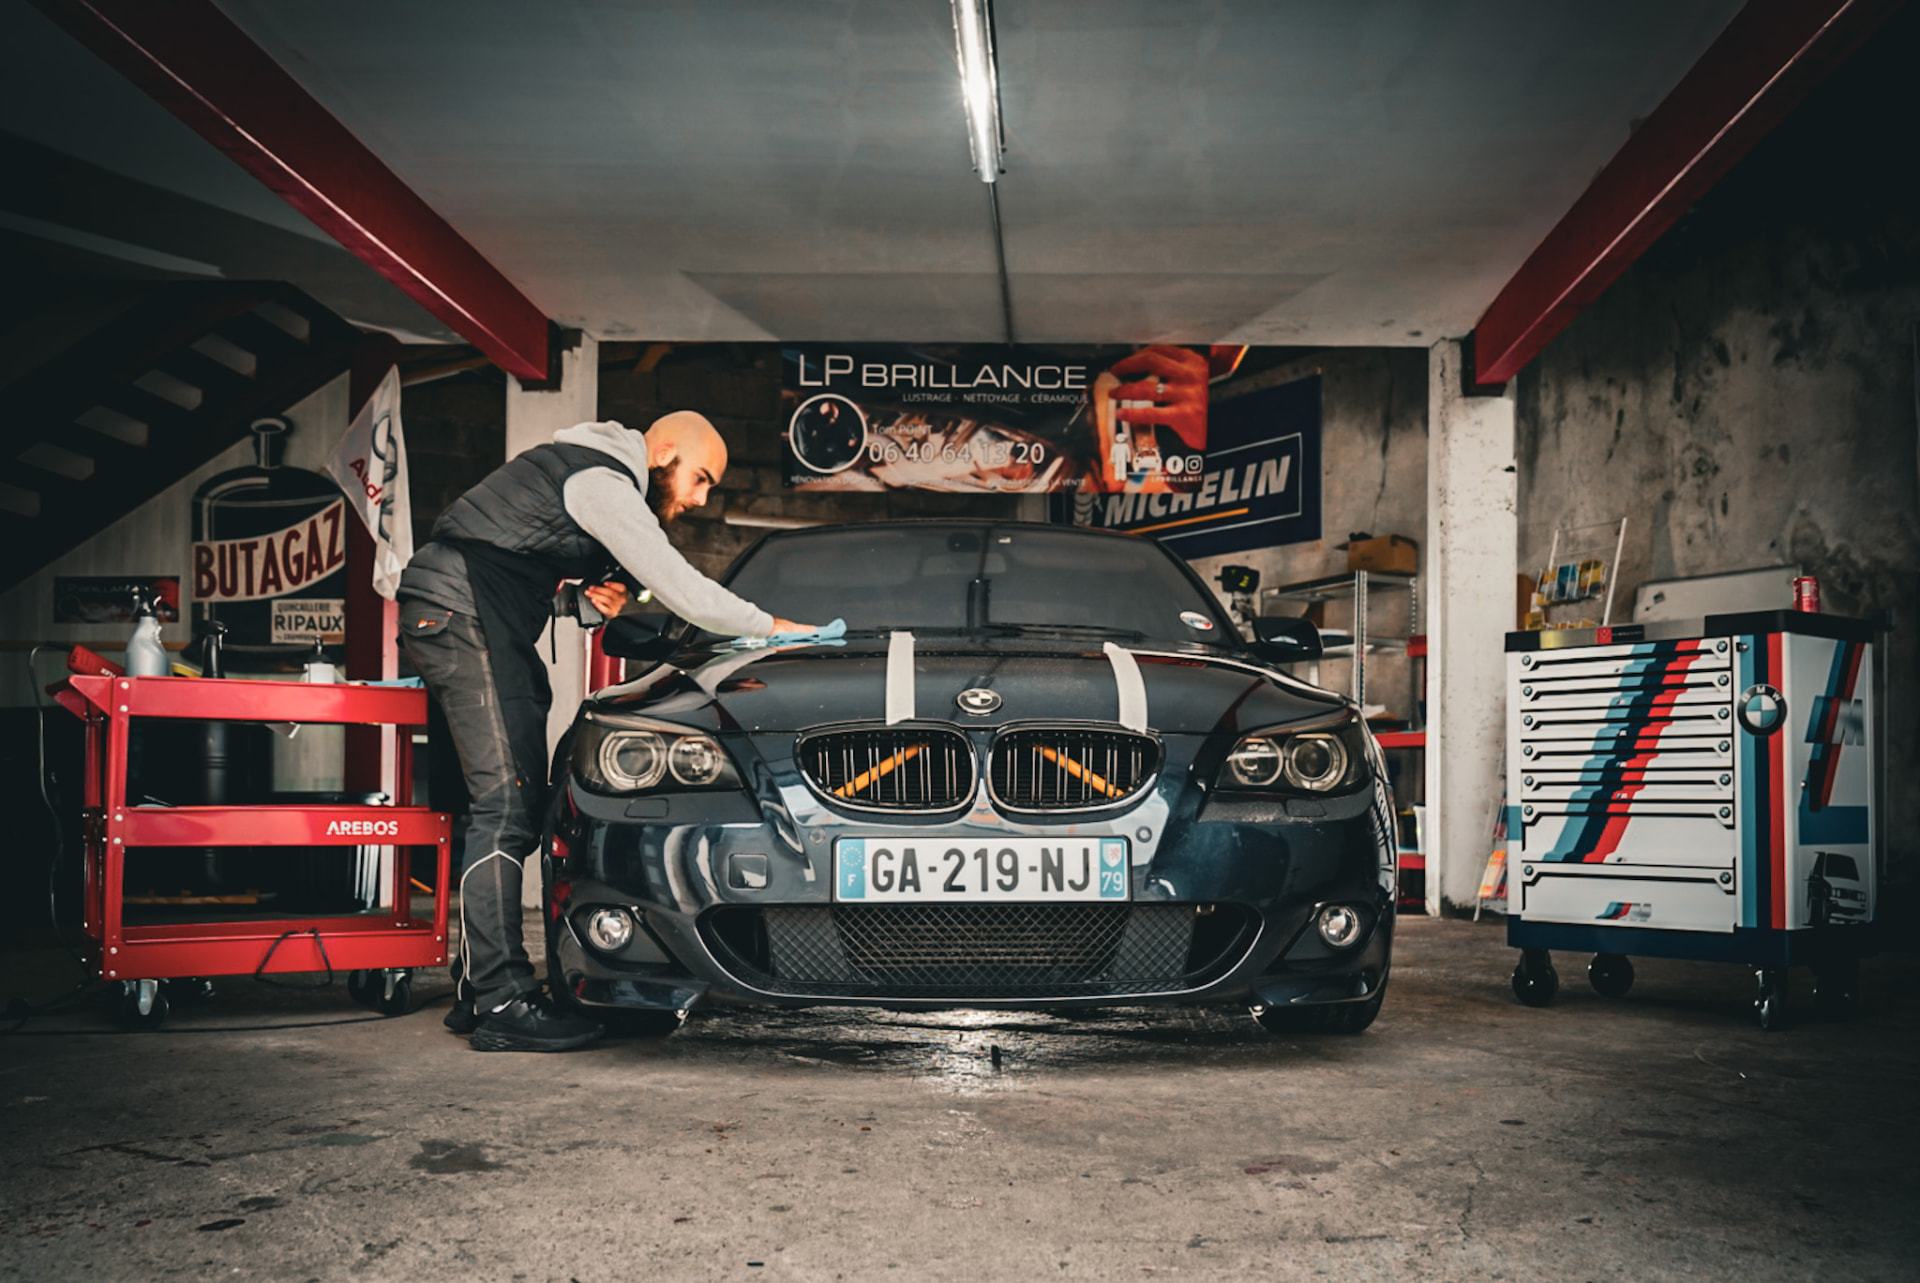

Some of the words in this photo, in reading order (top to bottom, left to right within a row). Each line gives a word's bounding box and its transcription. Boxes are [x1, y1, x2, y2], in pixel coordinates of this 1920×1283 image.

[799, 354, 854, 387] LP
[861, 363, 1087, 389] BRILLANCE
[902, 392, 952, 403] LUSTRAGE
[963, 393, 1020, 404] NETTOYAGE
[868, 441, 898, 463] 06
[905, 442, 934, 464] 40
[941, 442, 972, 464] 64
[981, 442, 1008, 465] 13
[1015, 442, 1045, 465] 20
[350, 457, 383, 506] Audi
[1103, 455, 1291, 527] MICHELIN
[194, 502, 345, 598] BUTAGAZ
[274, 614, 343, 632] RIPAUX
[326, 820, 399, 836] AREBOS
[847, 873, 857, 887] F
[871, 847, 1091, 893] GA-219-NJ
[1101, 871, 1124, 892] 79
